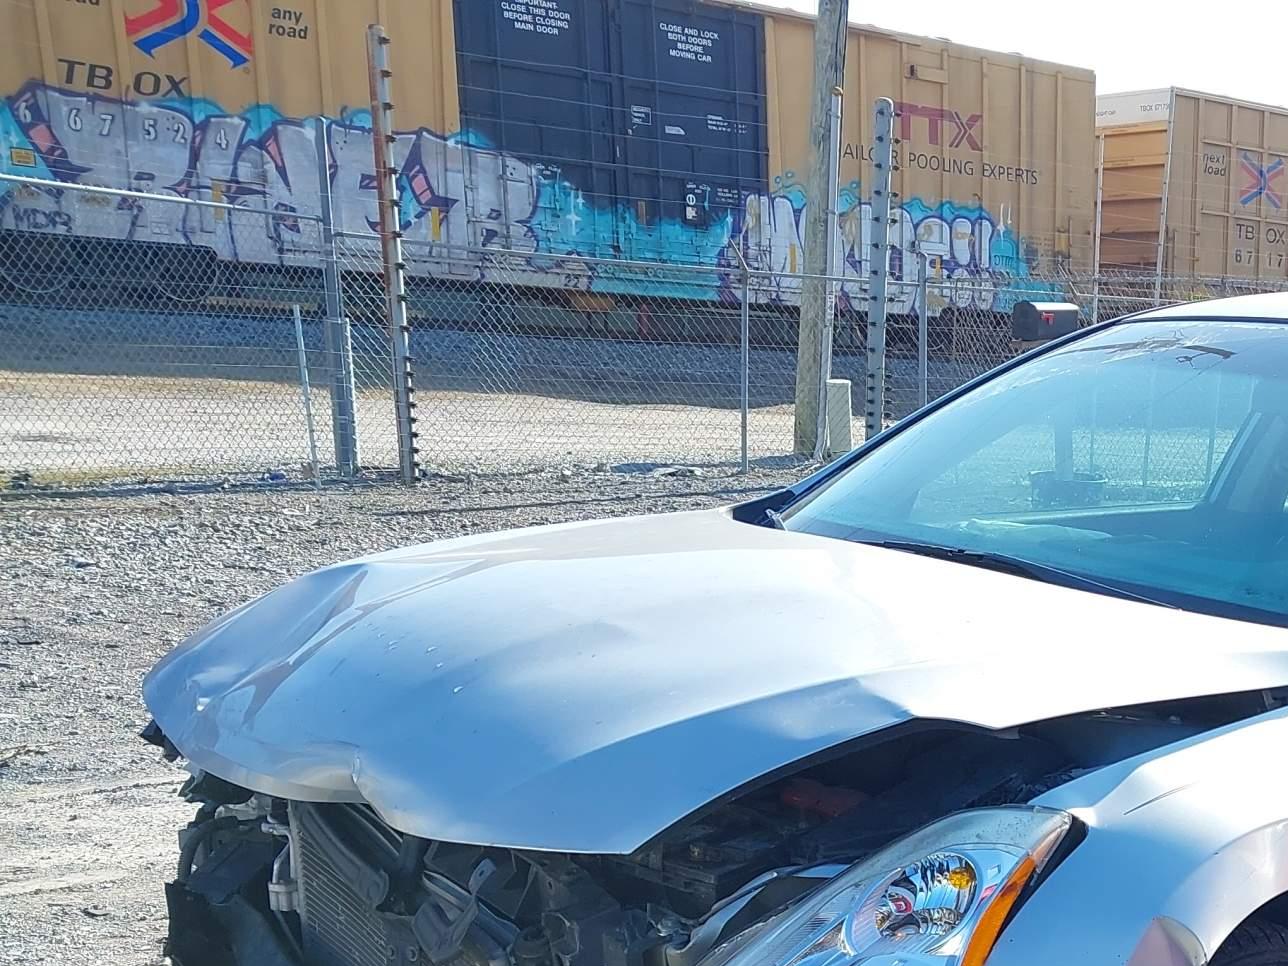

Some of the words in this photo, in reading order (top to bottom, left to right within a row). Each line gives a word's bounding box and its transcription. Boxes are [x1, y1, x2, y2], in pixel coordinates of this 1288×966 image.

[271, 7, 303, 25] any
[501, 2, 527, 13] CLOSE
[528, 6, 546, 16] THIS
[548, 10, 571, 21] DOOR
[503, 11, 534, 23] BEFORE
[536, 16, 569, 29] CLOSING
[268, 22, 308, 40] road
[514, 21, 534, 32] MAIN
[536, 25, 559, 36] DOOR
[659, 22, 683, 34] CLOSE
[684, 27, 699, 37] AND
[700, 30, 720, 41] LOCK
[667, 32, 687, 43] BOTH
[688, 36, 713, 47] DOORS
[669, 49, 696, 61] MOVING
[697, 54, 712, 63] CAR
[677, 42, 704, 54] BEFORE
[1203, 153, 1226, 164] next
[908, 151, 974, 176] POOLING
[982, 162, 1038, 185] EXPERTS
[1204, 162, 1227, 177] load
